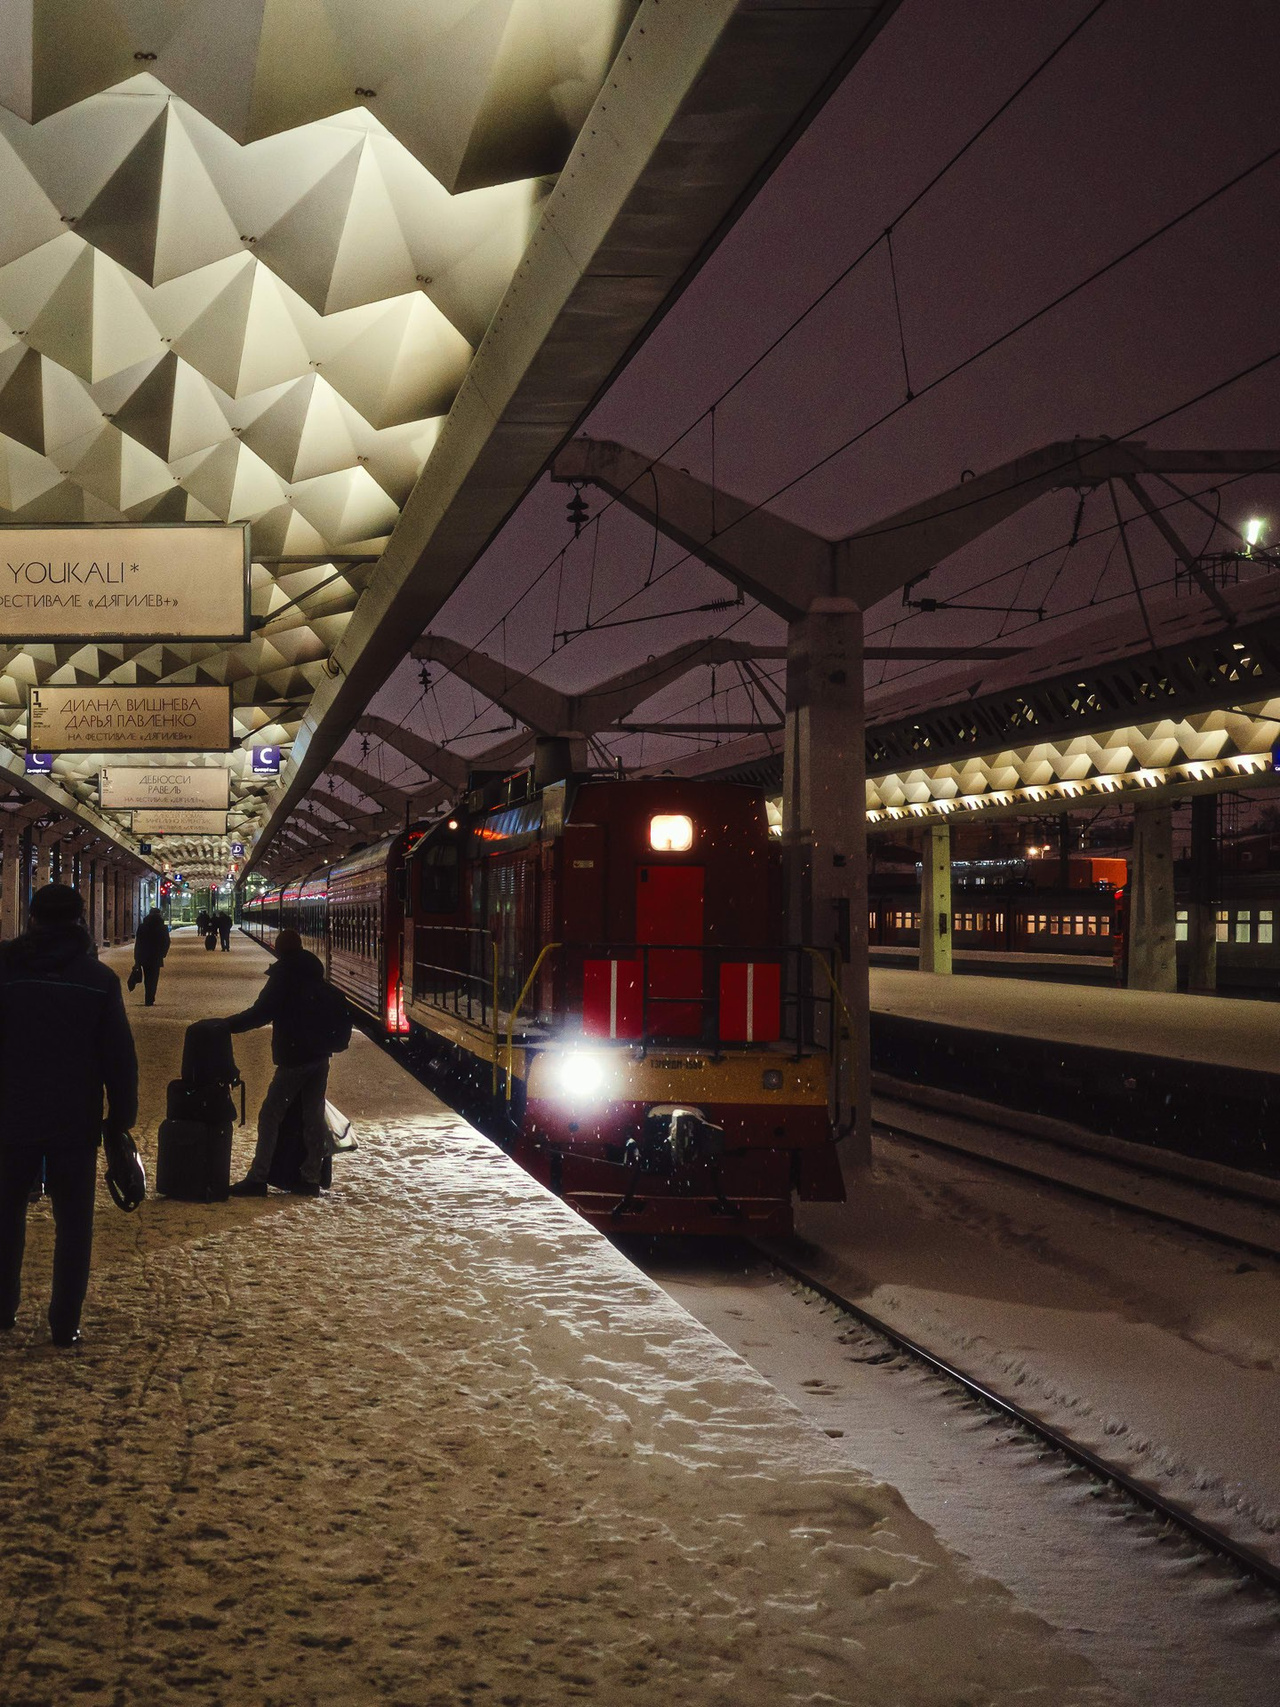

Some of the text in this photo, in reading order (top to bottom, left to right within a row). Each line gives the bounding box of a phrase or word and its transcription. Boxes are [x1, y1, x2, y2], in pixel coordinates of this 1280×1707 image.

[87, 594, 179, 609] «ДЯГИЛЕВ+»
[59, 699, 122, 714] ДИАНА
[126, 698, 202, 712] ВИШНЕВА
[64, 713, 197, 730] ДАРЬЯ ПАВЛЕНКО
[67, 733, 82, 741] НА
[85, 732, 137, 741] ФЕСТИВАЛЕ
[260, 747, 273, 765] C
[139, 775, 192, 785] ДЕБЮССИ
[147, 785, 182, 795] РАВЕЛЬ
